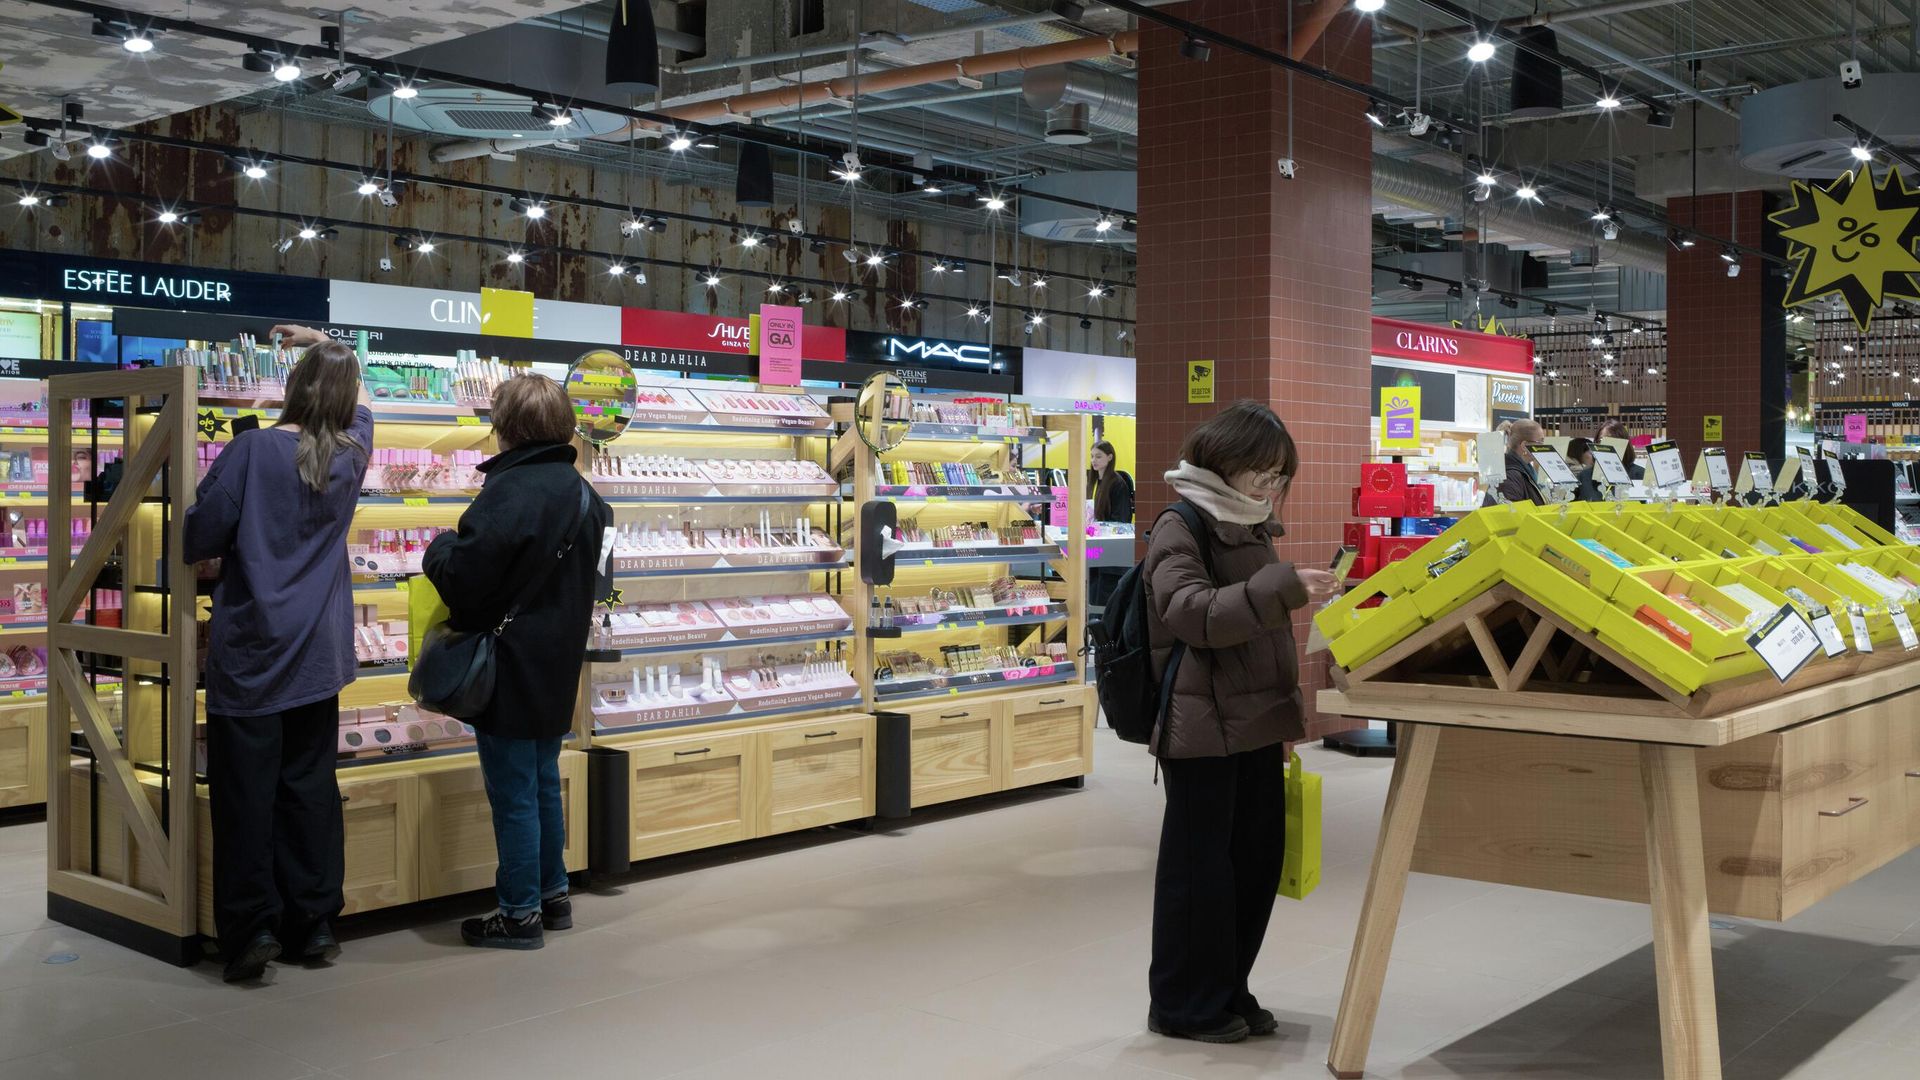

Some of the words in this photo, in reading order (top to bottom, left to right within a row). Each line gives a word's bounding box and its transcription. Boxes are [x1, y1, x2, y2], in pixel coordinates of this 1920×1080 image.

[141, 276, 231, 302] LAUDER
[337, 338, 357, 346] Beaut
[722, 340, 742, 348] GINZA
[770, 333, 792, 345] GA
[1396, 332, 1458, 356] CLARINS
[625, 349, 657, 363] DEAR
[661, 352, 707, 367] DAHLIA
[896, 369, 927, 378] EVELINE
[797, 419, 815, 427] Beauty
[614, 485, 638, 494] DEAR
[641, 485, 677, 494] DAHLIA
[620, 559, 646, 569] DEAR
[648, 558, 685, 568] DAHLIA
[750, 627, 778, 635] Redefining
[779, 625, 798, 633] Luxury
[611, 638, 643, 646] Redefining
[645, 636, 667, 644] Luxury
[668, 634, 686, 642] Vegan
[687, 633, 707, 641] Beauty
[758, 698, 787, 706] Redefining
[787, 695, 807, 704] Luxury
[808, 693, 824, 701] Vegan
[824, 691, 842, 699] Beauty
[637, 711, 661, 722] DEAR
[665, 706, 701, 719] DAHLIA
